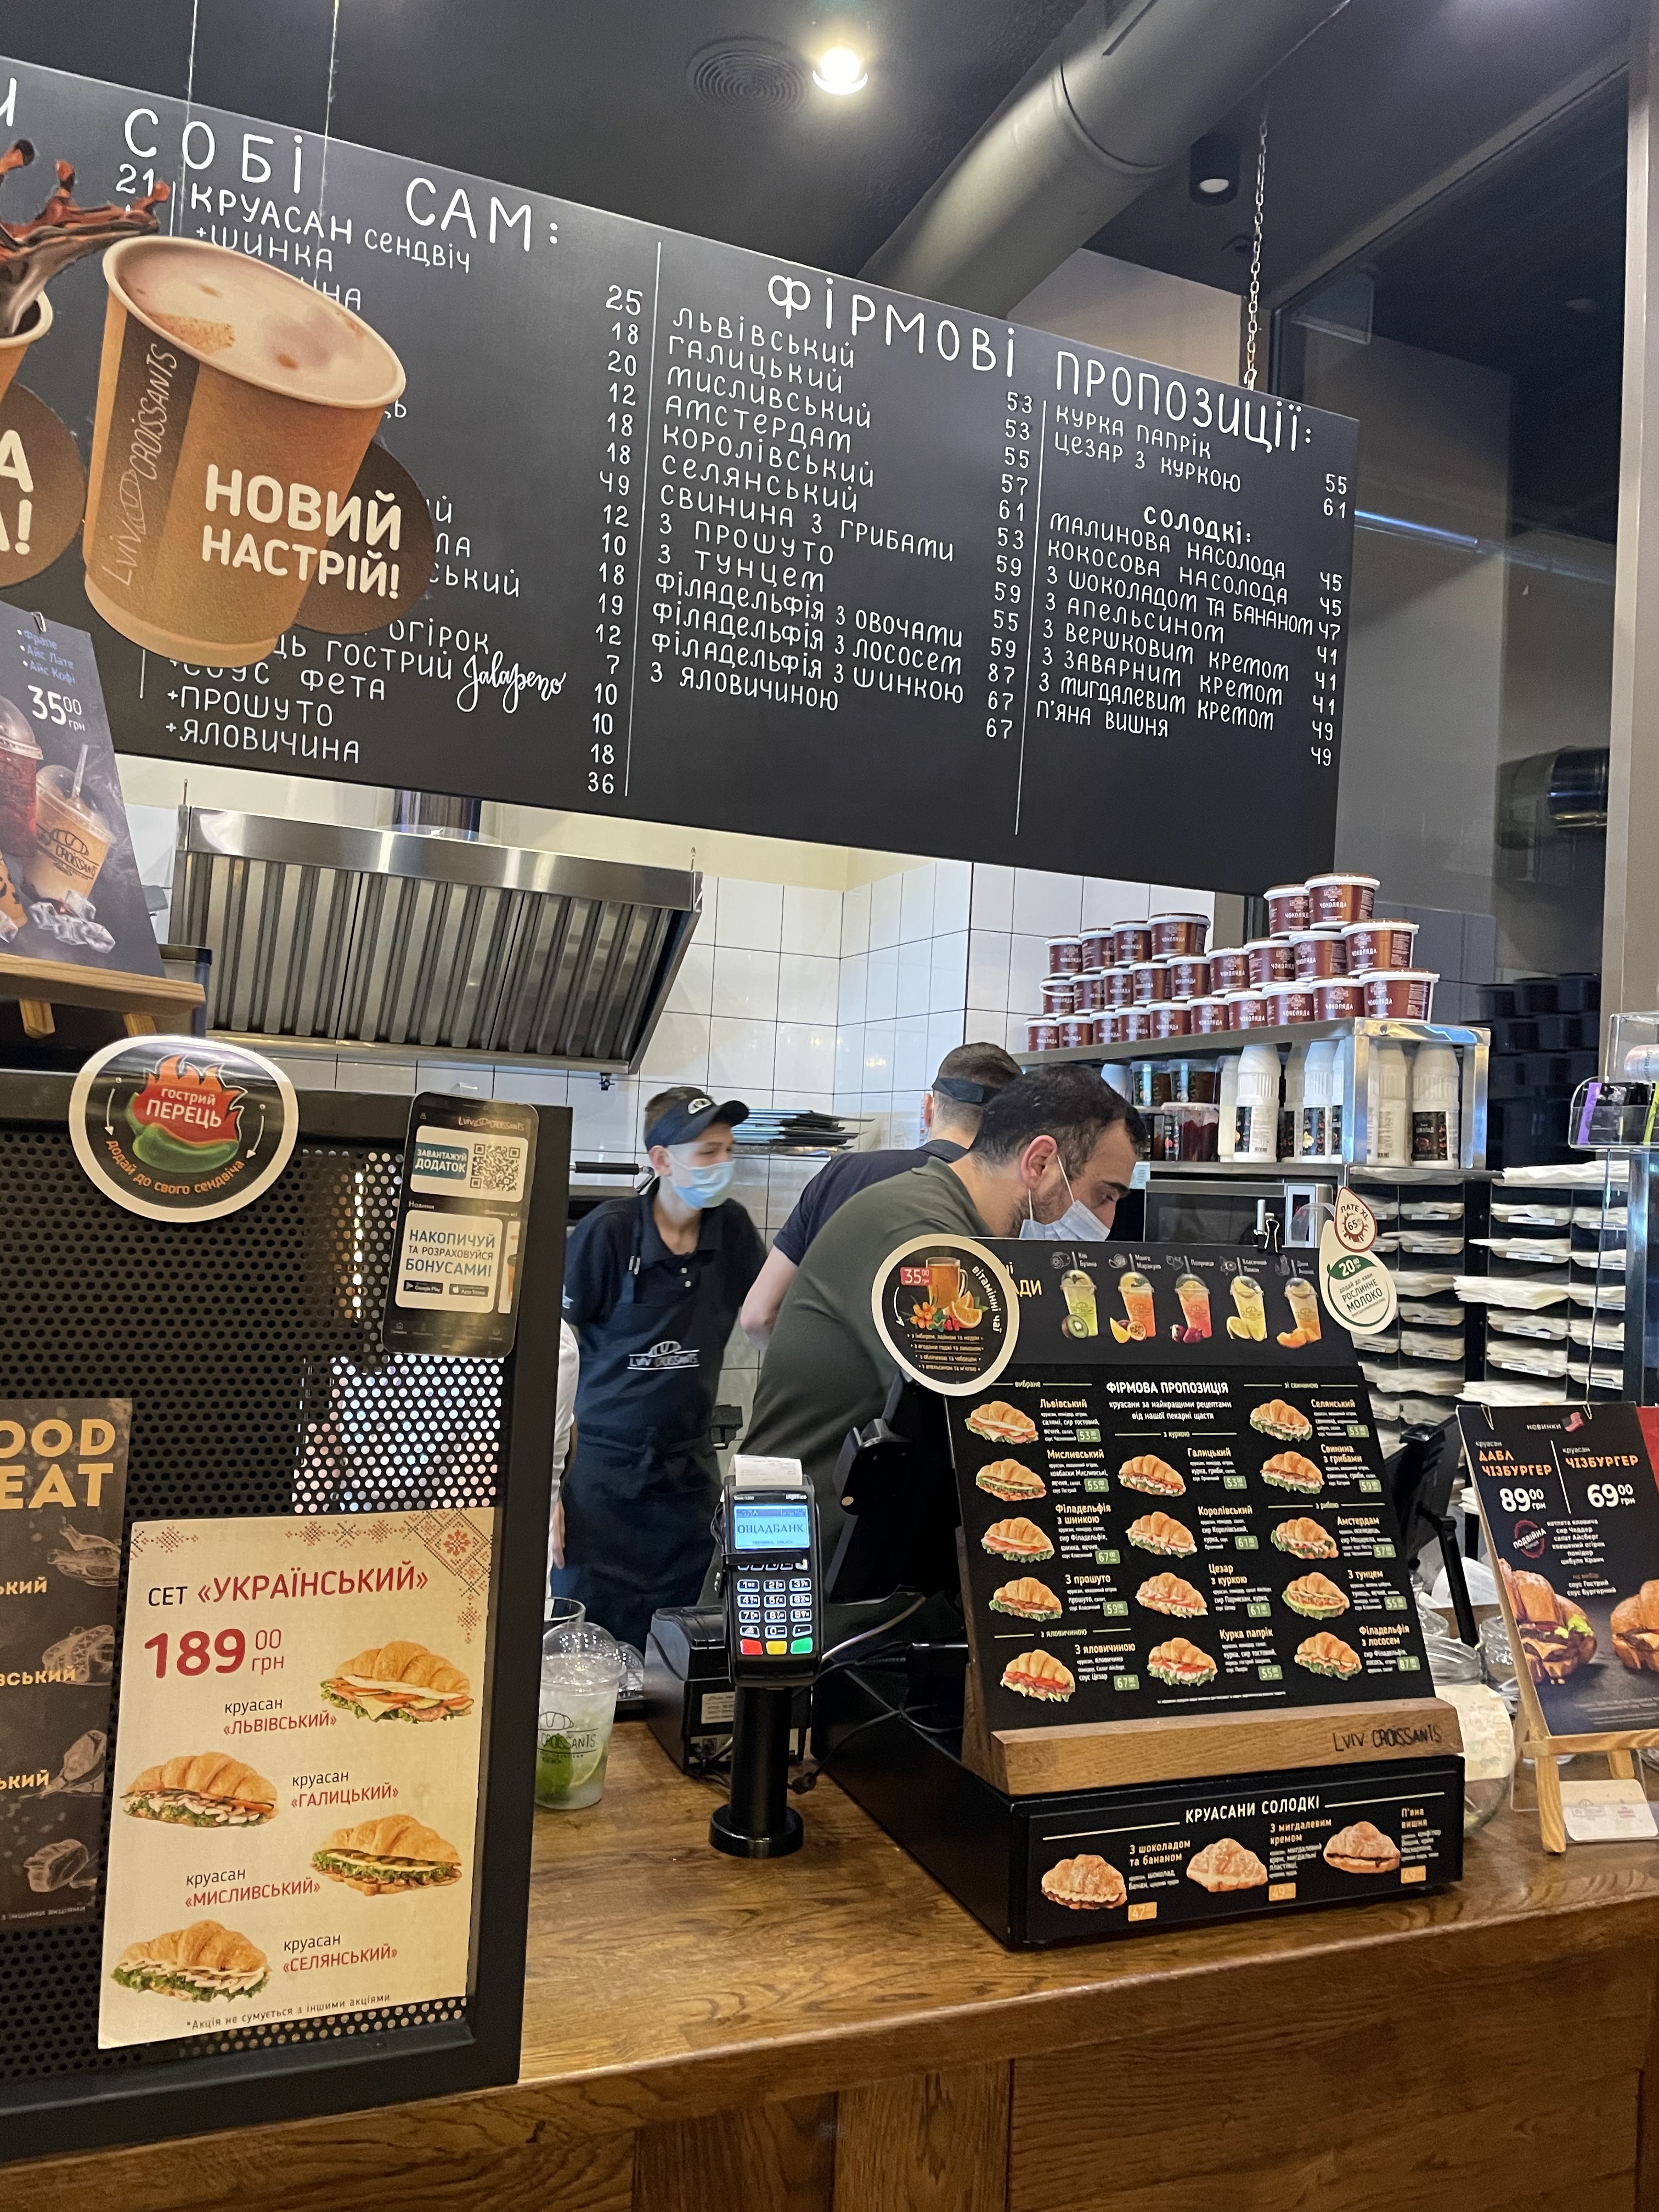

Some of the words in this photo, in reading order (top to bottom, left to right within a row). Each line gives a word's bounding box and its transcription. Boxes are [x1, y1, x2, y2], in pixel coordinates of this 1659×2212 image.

[125, 109, 302, 196] СОБІ
[191, 183, 351, 244] КРУАСАН
[365, 229, 469, 273] сендвіч
[606, 285, 642, 315] 25
[673, 308, 853, 370] ЛЬВІВСЬКИЙ
[668, 334, 841, 396] ГАЛИЦЬКИЙ
[768, 275, 1014, 377] ФІРМОВІ
[1056, 351, 1311, 455] ПРОПОЗИЦІЇ:
[666, 363, 870, 430] МИСЛИВСЬКИЙ
[1057, 405, 1123, 437] КУРКА
[1137, 425, 1210, 459] ПАПРІК
[663, 422, 873, 487] КОРОЛІВСЬКИЙ
[1002, 474, 1028, 495] 57
[205, 464, 400, 551] НОВИЙ
[661, 485, 792, 527] СВИНИНА
[841, 520, 952, 561] ГРИБАМИ
[696, 521, 833, 564] ПРОШУТО
[1051, 510, 1172, 552] МАЛИНОВА
[1188, 542, 1284, 580] НАСОЛОДА
[202, 524, 399, 599] НАСТРІЙ!
[1048, 539, 1159, 577] КОКОСОВА
[1180, 567, 1286, 606] НАСОЛОДА
[1068, 567, 1197, 615] ШОКОЛАДОМ
[1206, 597, 1223, 617] ТА
[1234, 603, 1312, 635] БАНАНОМ
[1319, 622, 1340, 640] 47
[856, 610, 962, 647] ОВОЧАМИ
[328, 641, 451, 680] ГОСТРИЙ
[989, 663, 1014, 684] 87
[27, 685, 66, 725] 35
[64, 699, 82, 715] 00
[69, 720, 85, 732] грн
[1106, 711, 1167, 737] ВИШНЯ
[161, 1088, 216, 1106] гострий
[146, 1099, 222, 1129] ПЕРЕЦЬ
[106, 1140, 137, 1175] додай
[133, 1173, 151, 1187] до
[154, 1182, 190, 1194] свого
[194, 1160, 245, 1193] сендвіча
[415, 1158, 466, 1173] ДОДАТОК
[1341, 1204, 1359, 1213] ЛАТЕ
[409, 1229, 495, 1248] НАКОПИЧУЙ
[409, 1245, 419, 1254] ТА
[422, 1247, 493, 1260] РОЗРАХОВУЙСЯ
[405, 1259, 492, 1277] БОНУСАМИ!
[904, 1269, 922, 1284] 35
[972, 1266, 1002, 1312] вітамінні
[1342, 1279, 1378, 1302] РОСЛИННЕ
[1346, 1288, 1383, 1312] МОЛОКО
[1107, 1382, 1158, 1393] ФІРМОВА
[1160, 1382, 1228, 1395] ПРОПОЗИЦІЯ
[1040, 1398, 1087, 1409] Львівський
[1109, 1401, 1140, 1410] круасани
[1152, 1400, 1195, 1409] найкращими
[1197, 1401, 1232, 1409] рецептами
[1311, 1399, 1355, 1408] Селянський
[1132, 1412, 1143, 1420] від
[1144, 1412, 1165, 1421] нашої
[1167, 1412, 1193, 1420] пекарні
[1194, 1412, 1214, 1420] щастя
[1080, 1431, 1090, 1440] 53
[1047, 1449, 1104, 1459] Мисливський
[1188, 1447, 1231, 1458] Галицький
[1330, 1454, 1362, 1464] грибами
[1479, 1450, 1514, 1462] ДАБЛ
[1482, 1464, 1553, 1477] ЧІЗБУРГЕР
[1566, 1455, 1639, 1469] ЧІЗБУРГЕР
[1499, 1488, 1531, 1512] 89
[1530, 1488, 1544, 1500] 00
[1587, 1483, 1619, 1508] 69
[1618, 1484, 1633, 1495] 00
[1621, 1498, 1635, 1506] грн
[1056, 1503, 1111, 1515] Філадельфія
[1198, 1505, 1252, 1516] Королівський
[737, 1524, 804, 1534] ОЩАДБАНК
[1065, 1516, 1099, 1524] шинкою
[1338, 1517, 1379, 1526] Амстердам
[1098, 1552, 1109, 1562] 67
[1209, 1564, 1233, 1575] Цезар
[1355, 1570, 1383, 1580] тунцем
[148, 1586, 188, 1607] СЕТ
[198, 1560, 428, 1603] «УКРАЇНСЬКИЙ»
[1074, 1575, 1110, 1585] прошуто
[1218, 1576, 1248, 1585] куркою
[1219, 1629, 1244, 1640] Курка
[1246, 1627, 1273, 1638] папрік
[1359, 1624, 1409, 1636] Філадельфія
[1084, 1643, 1136, 1654] яловичиною
[1368, 1637, 1400, 1646] лососем
[144, 1628, 246, 1679] 189
[256, 1629, 282, 1650] 00
[252, 1656, 284, 1674] грн
[225, 1699, 283, 1715] круасан
[223, 1711, 337, 1736] «ЛЬВІВСЬКИЙ»
[292, 1770, 349, 1788] круасан
[291, 1782, 399, 1809] «ГАЛИЦЬКИЙ»
[1186, 1802, 1256, 1825] КРУАСАНИ
[1261, 1795, 1319, 1816] СОЛОДКІ
[1279, 1818, 1332, 1833] мигдалевим
[1139, 1839, 1191, 1853] шоколадом
[1130, 1857, 1139, 1866] та
[1142, 1853, 1183, 1865] бананом
[186, 1867, 246, 1886] круасан
[185, 1879, 320, 1908] «МИСЛИВСЬКИЙ»
[284, 1933, 341, 1953] круасан
[283, 1943, 397, 1973] «СЕЛЯНСЬКИЙ»
[225, 2013, 237, 2025] не
[241, 2006, 292, 2023] сумується
[307, 1998, 345, 2012] іншими
[350, 1994, 390, 2007] акціями
